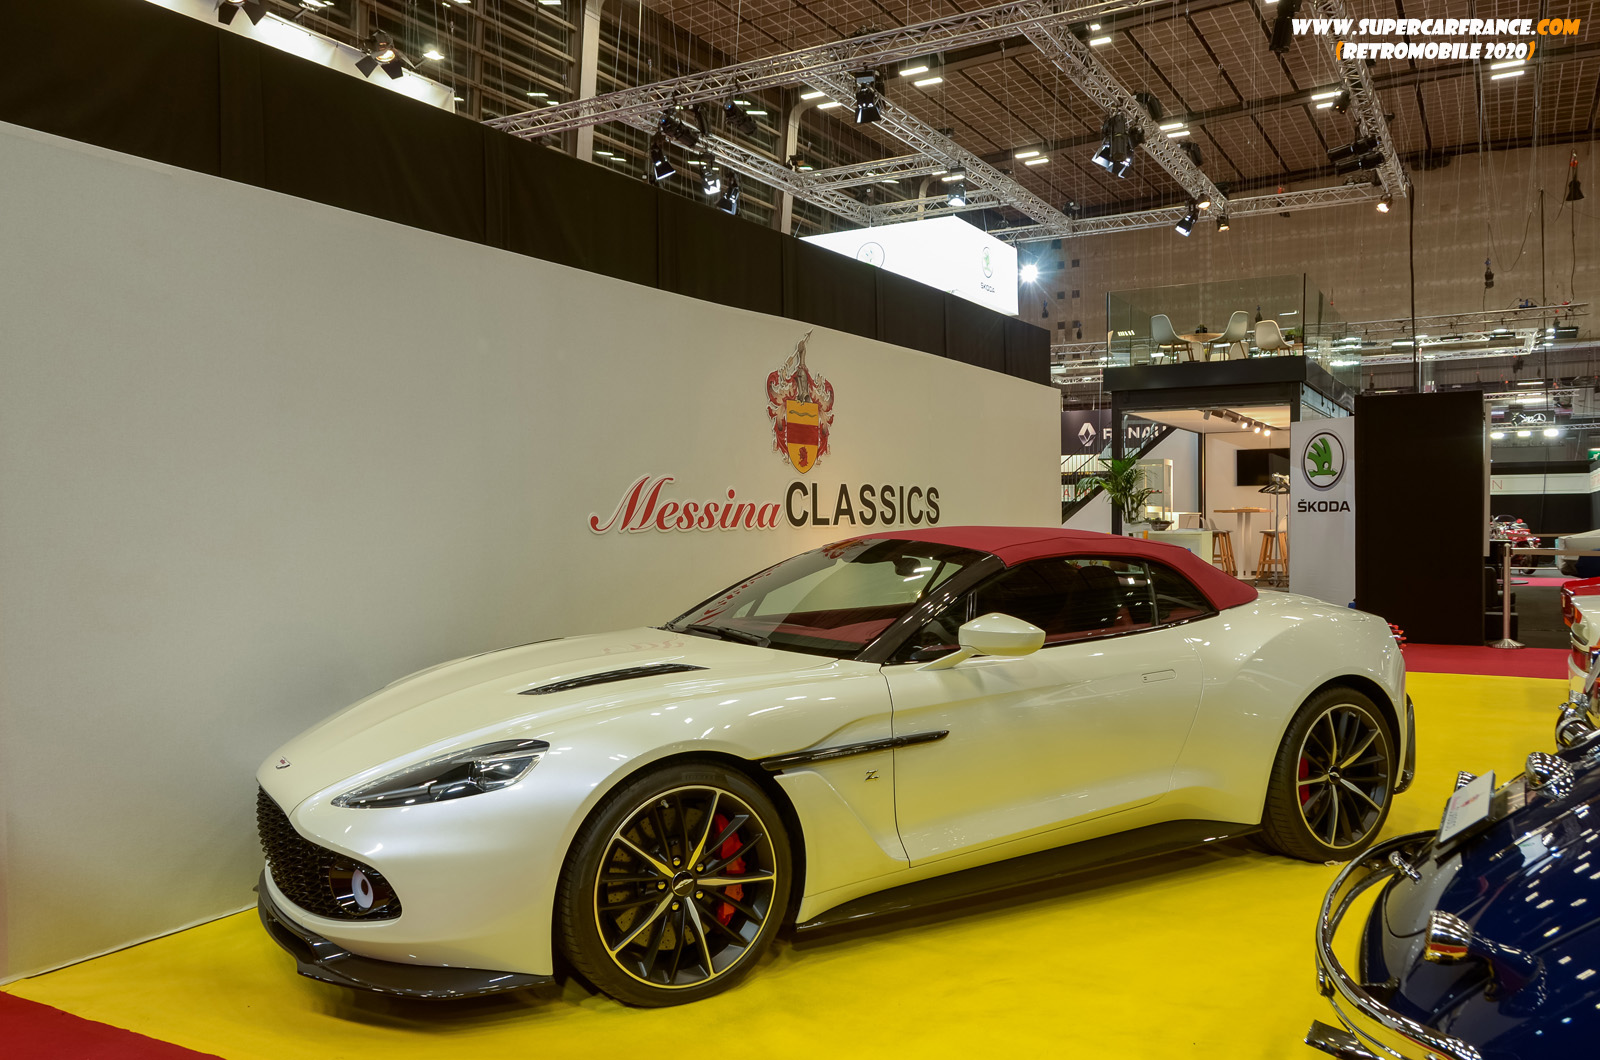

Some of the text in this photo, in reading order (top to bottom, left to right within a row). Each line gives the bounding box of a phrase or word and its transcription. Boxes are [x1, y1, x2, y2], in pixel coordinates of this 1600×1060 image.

[590, 475, 940, 531] Messina CLASSICS
[1297, 499, 1351, 512] ŠKODA
